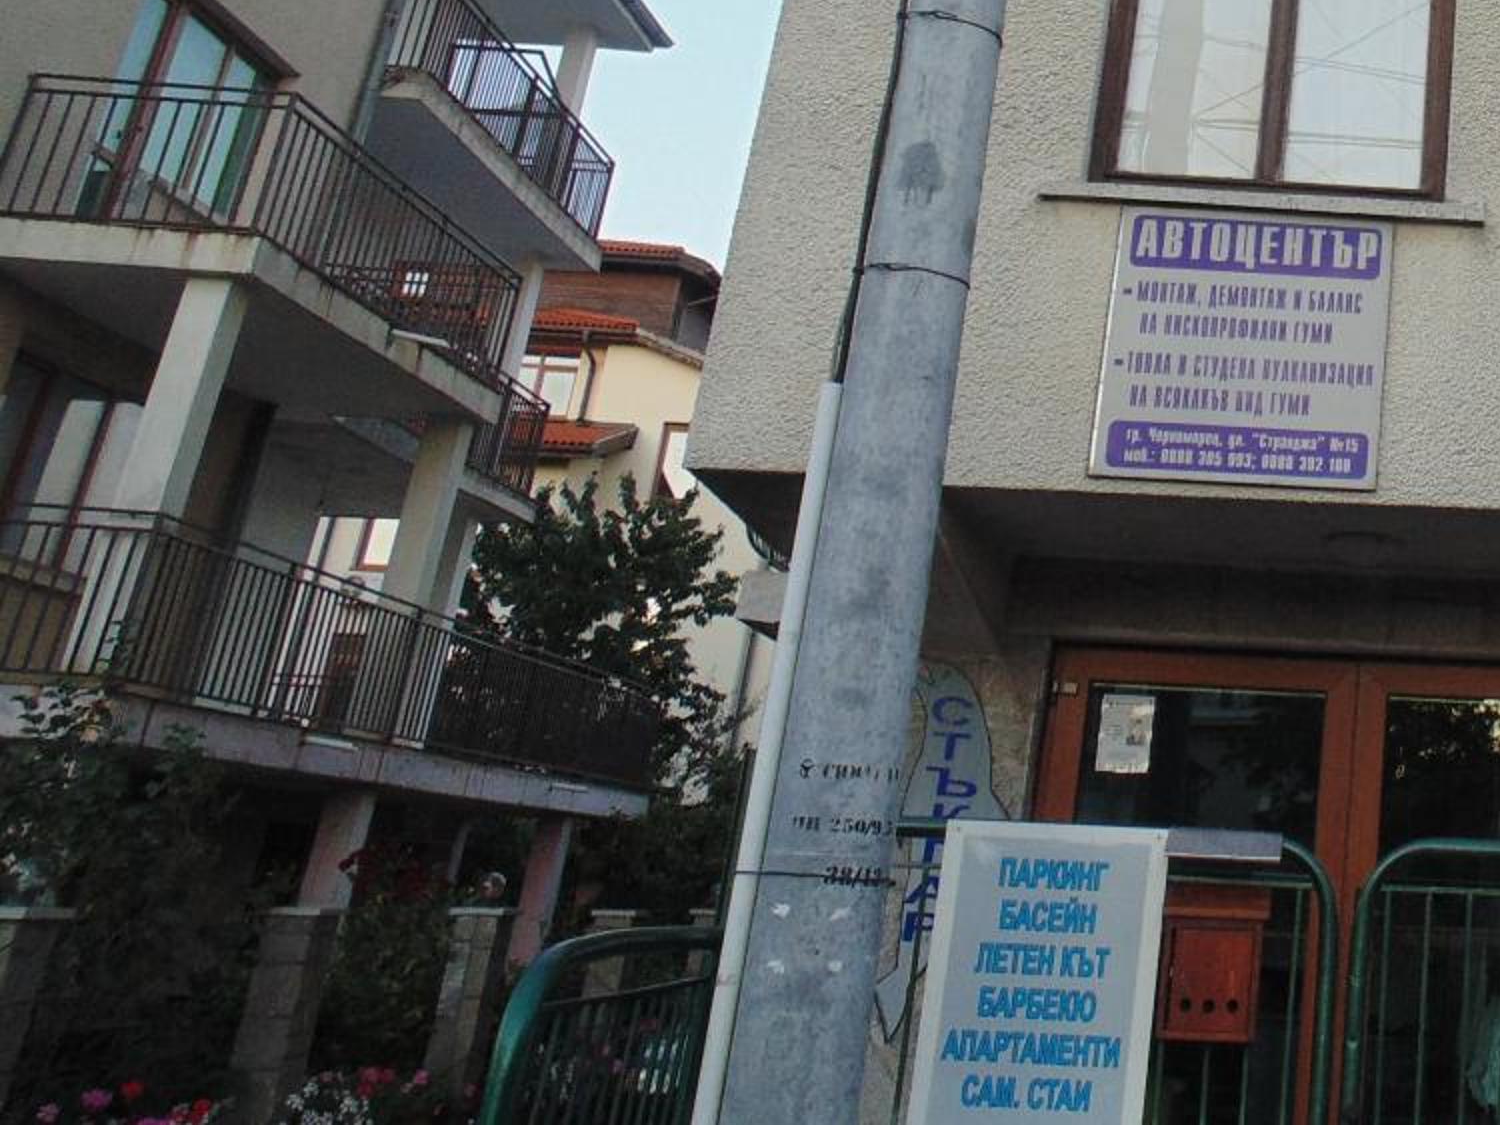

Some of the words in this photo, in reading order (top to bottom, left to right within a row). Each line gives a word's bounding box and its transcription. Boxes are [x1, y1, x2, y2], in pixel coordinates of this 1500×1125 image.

[1135, 219, 1378, 270] АВТОЦЕНТЪР
[1208, 283, 1286, 310] ДЕМОНТАЖ
[1294, 289, 1302, 311] И
[1308, 290, 1362, 314] БАЛАНС
[1140, 312, 1157, 335] НА
[1164, 314, 1287, 342] НИСКОПРОФИЛНИ
[1294, 321, 1333, 344] ГУМИ
[1178, 354, 1187, 376] И
[1193, 355, 1255, 381] СТУДЕНА
[1262, 358, 1375, 388] ВУЛКАНИЗАЦИЯ
[1130, 384, 1147, 408] НА
[1154, 386, 1229, 412] ВСЯКАКЪВ
[1235, 390, 1263, 416] ВИД
[1269, 392, 1311, 416] ГУМИ
[998, 857, 1110, 892] ПАРКИНГ
[999, 897, 1097, 935] БАСЕЙН
[974, 942, 1055, 976] ЛЕТЕН
[1059, 946, 1110, 978] КЪТ
[976, 985, 1097, 1022] БАРБЕКЮ
[941, 1028, 1121, 1068] АПАРТАМЕНТИ
[960, 1074, 1020, 1108] САМ.
[1027, 1078, 1093, 1112] СТАИ
